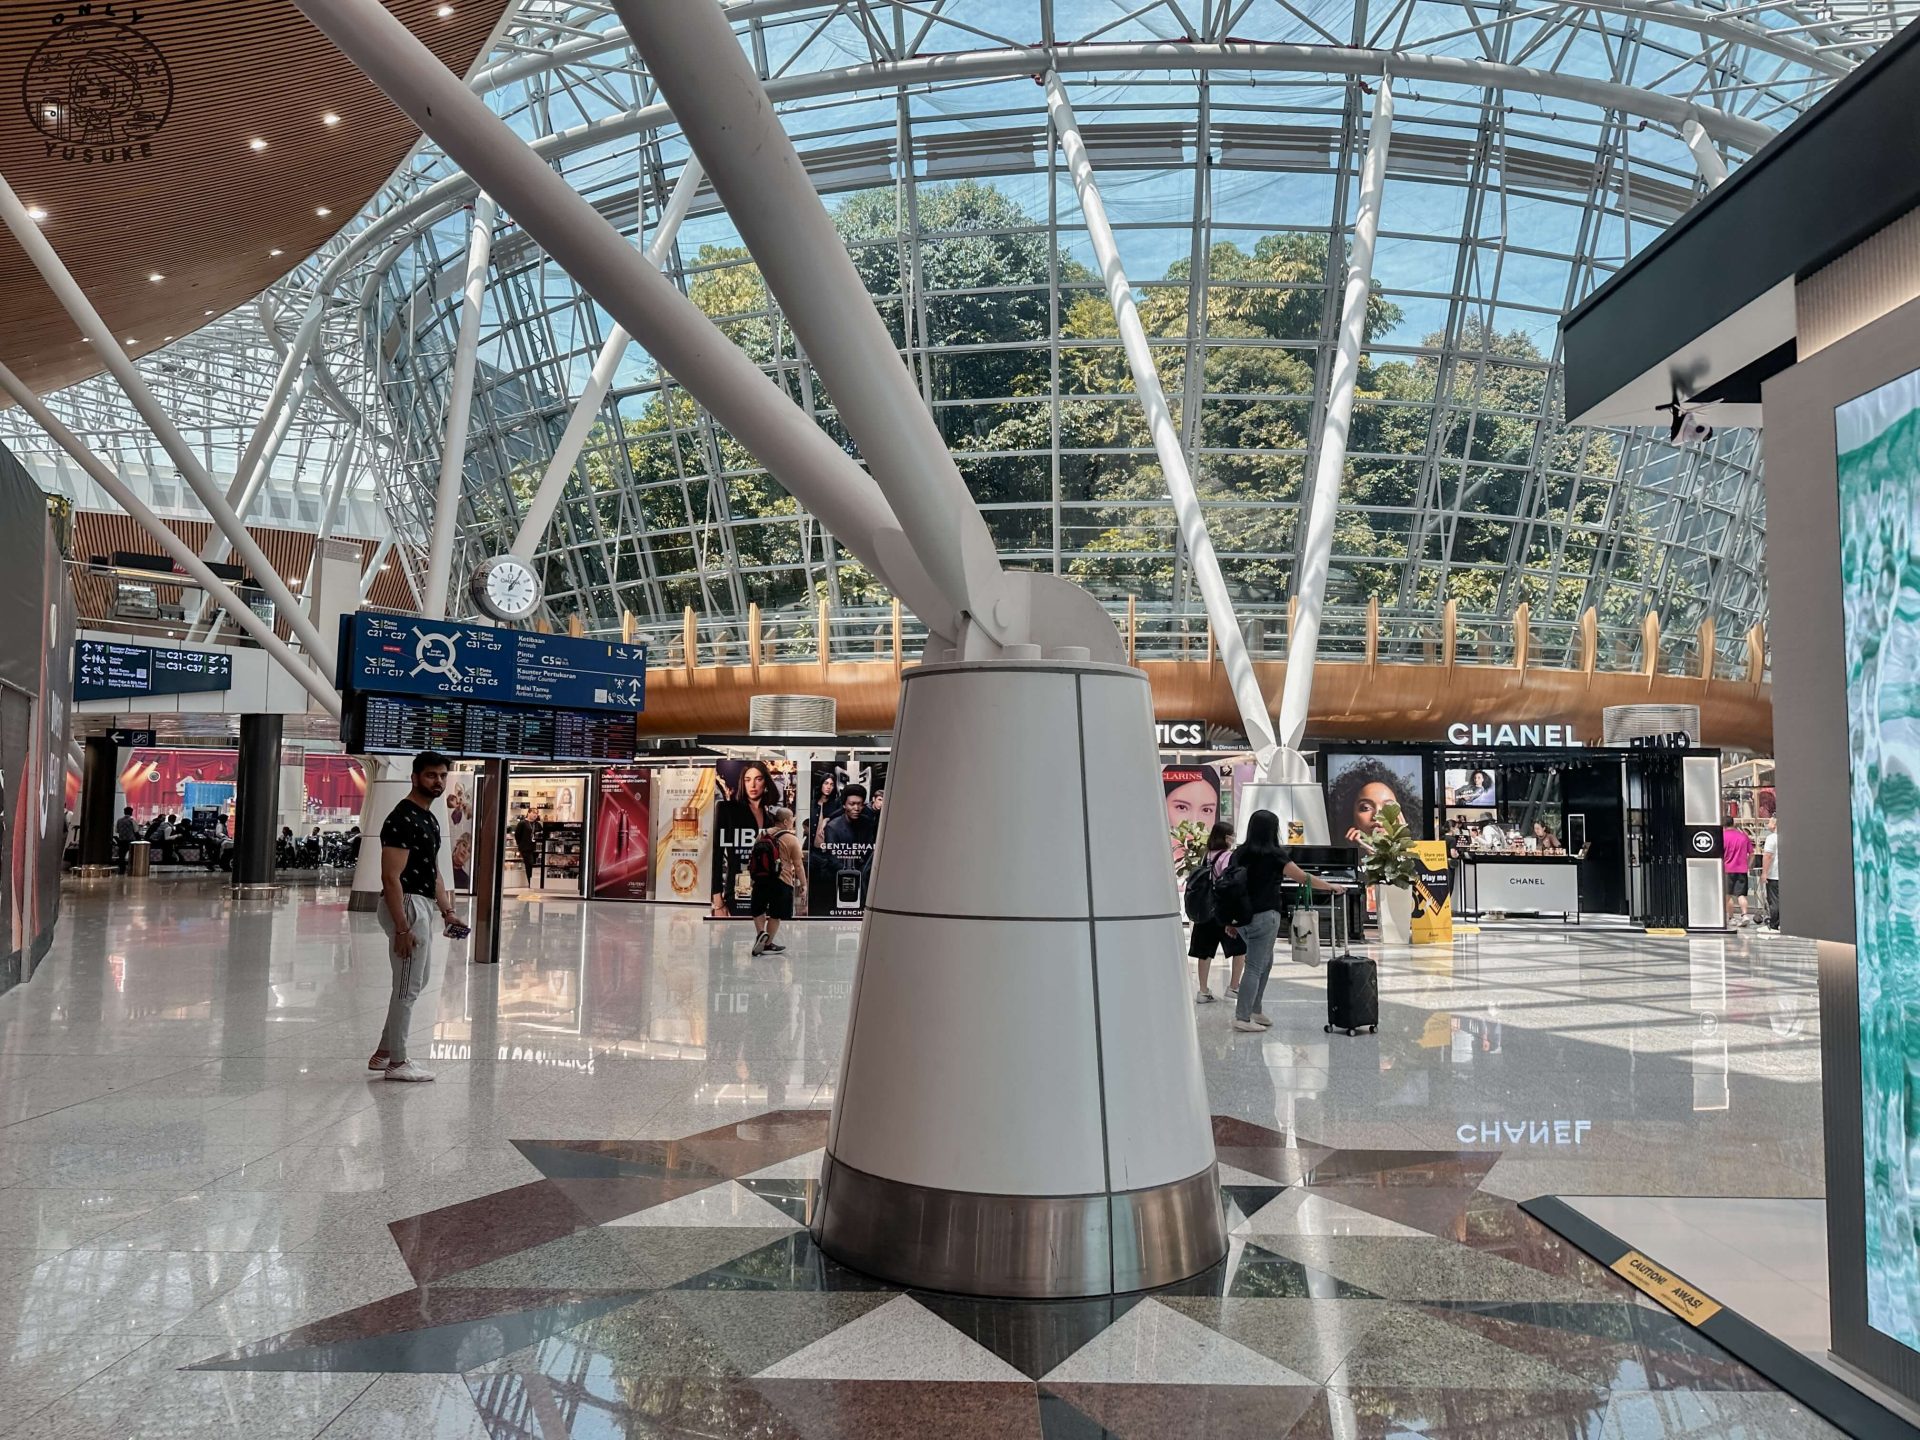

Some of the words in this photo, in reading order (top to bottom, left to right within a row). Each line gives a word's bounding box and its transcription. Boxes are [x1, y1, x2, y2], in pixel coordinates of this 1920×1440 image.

[367, 630, 382, 638] C21
[466, 640, 480, 648] C31
[518, 635, 546, 644] Ketibaan
[517, 668, 542, 676] Kaunter
[1448, 722, 1582, 747] CHANEL
[720, 828, 768, 848] LIB
[1422, 874, 1436, 882] Play
[1630, 1259, 1668, 1286] CAUTION!
[1672, 1287, 1704, 1310] AWAS!
